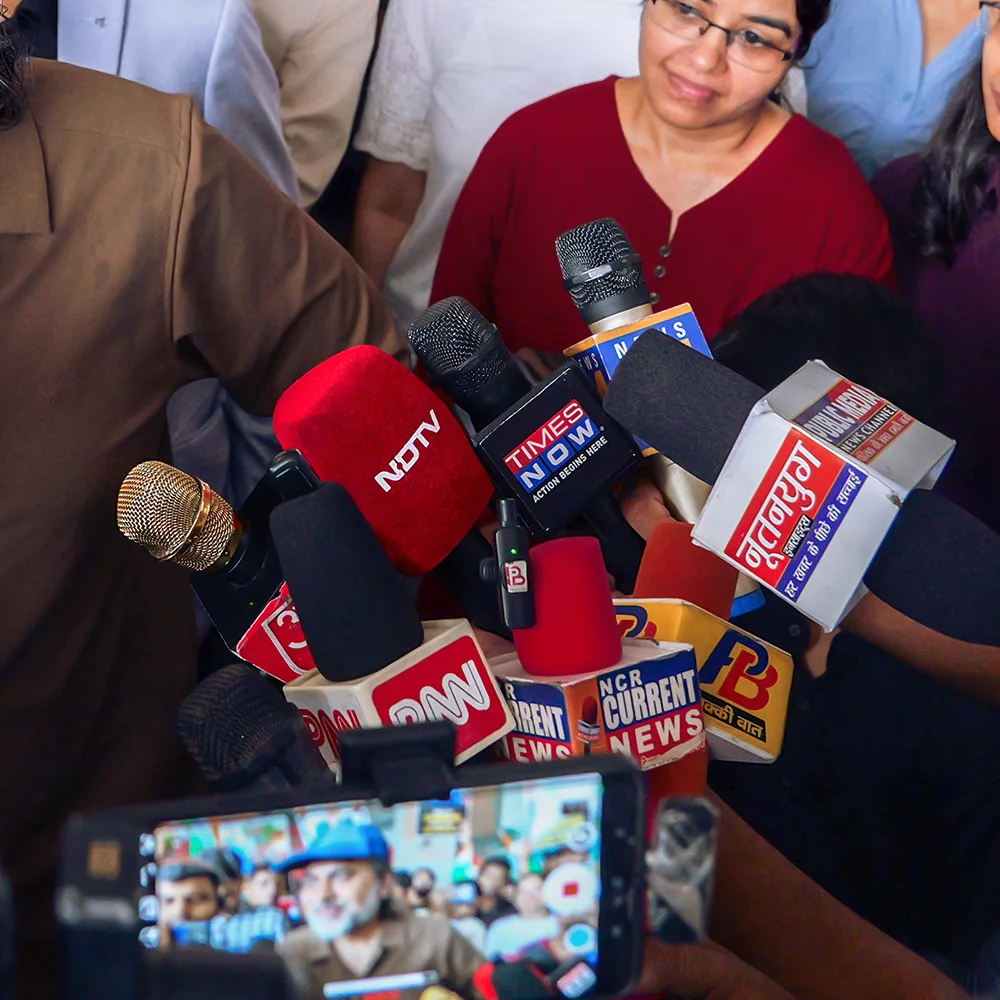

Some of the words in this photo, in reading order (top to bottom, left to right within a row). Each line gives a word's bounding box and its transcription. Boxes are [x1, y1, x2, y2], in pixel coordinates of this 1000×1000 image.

[504, 402, 584, 469] TIMES
[803, 405, 856, 442] PUBLIC
[831, 385, 879, 420] MEDIA
[840, 431, 867, 453] NEWS
[374, 408, 441, 493] NDTV
[520, 418, 594, 489] NOW
[532, 476, 561, 503] ACTION
[558, 453, 587, 480] BEGINS
[585, 435, 608, 457] HERE
[735, 439, 822, 570] नूतनयुग
[785, 580, 799, 598] हर
[806, 541, 820, 557] के
[826, 504, 842, 522] की
[600, 668, 643, 698] NCR
[602, 669, 697, 731] CURRENT
[609, 708, 705, 755] NEWS
[736, 715, 764, 738] बात
